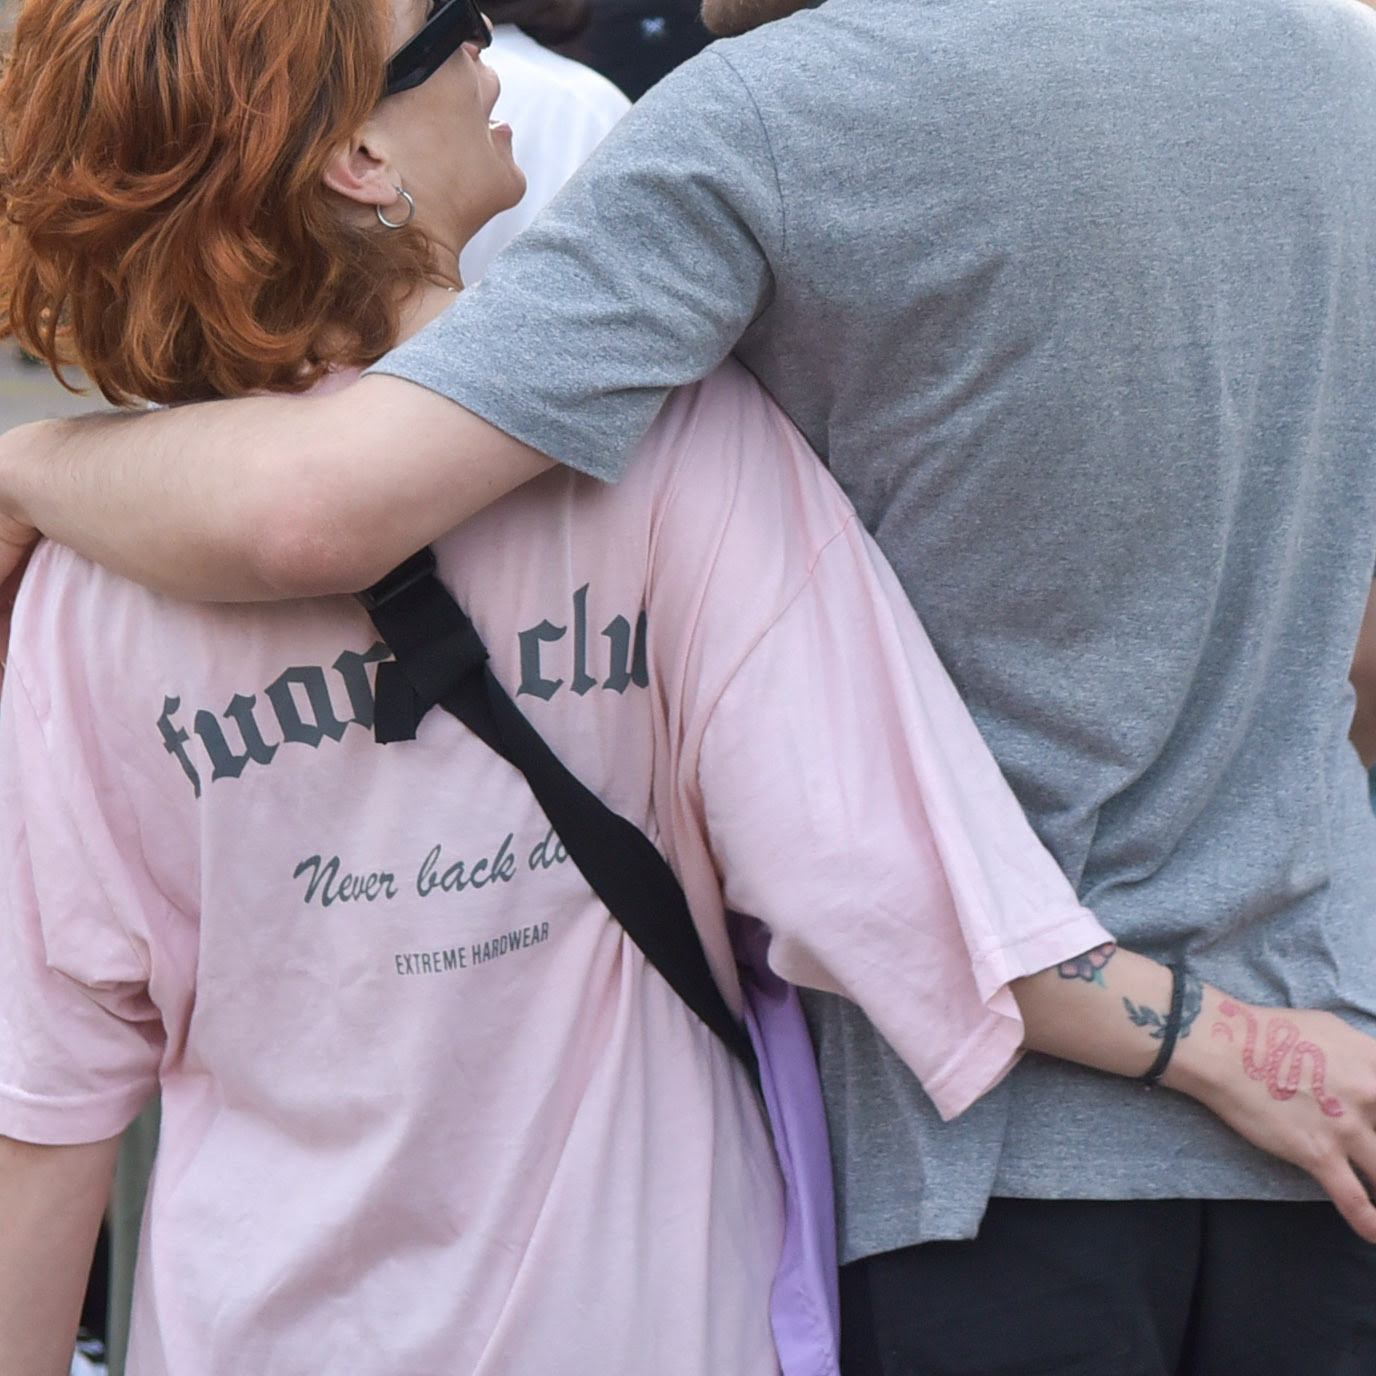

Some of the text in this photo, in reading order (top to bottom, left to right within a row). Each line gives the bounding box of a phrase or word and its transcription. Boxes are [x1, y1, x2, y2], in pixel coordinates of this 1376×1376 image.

[293, 854, 399, 907] Never
[416, 832, 517, 897] back
[394, 921, 550, 976] EXTREME HARDWEAR
